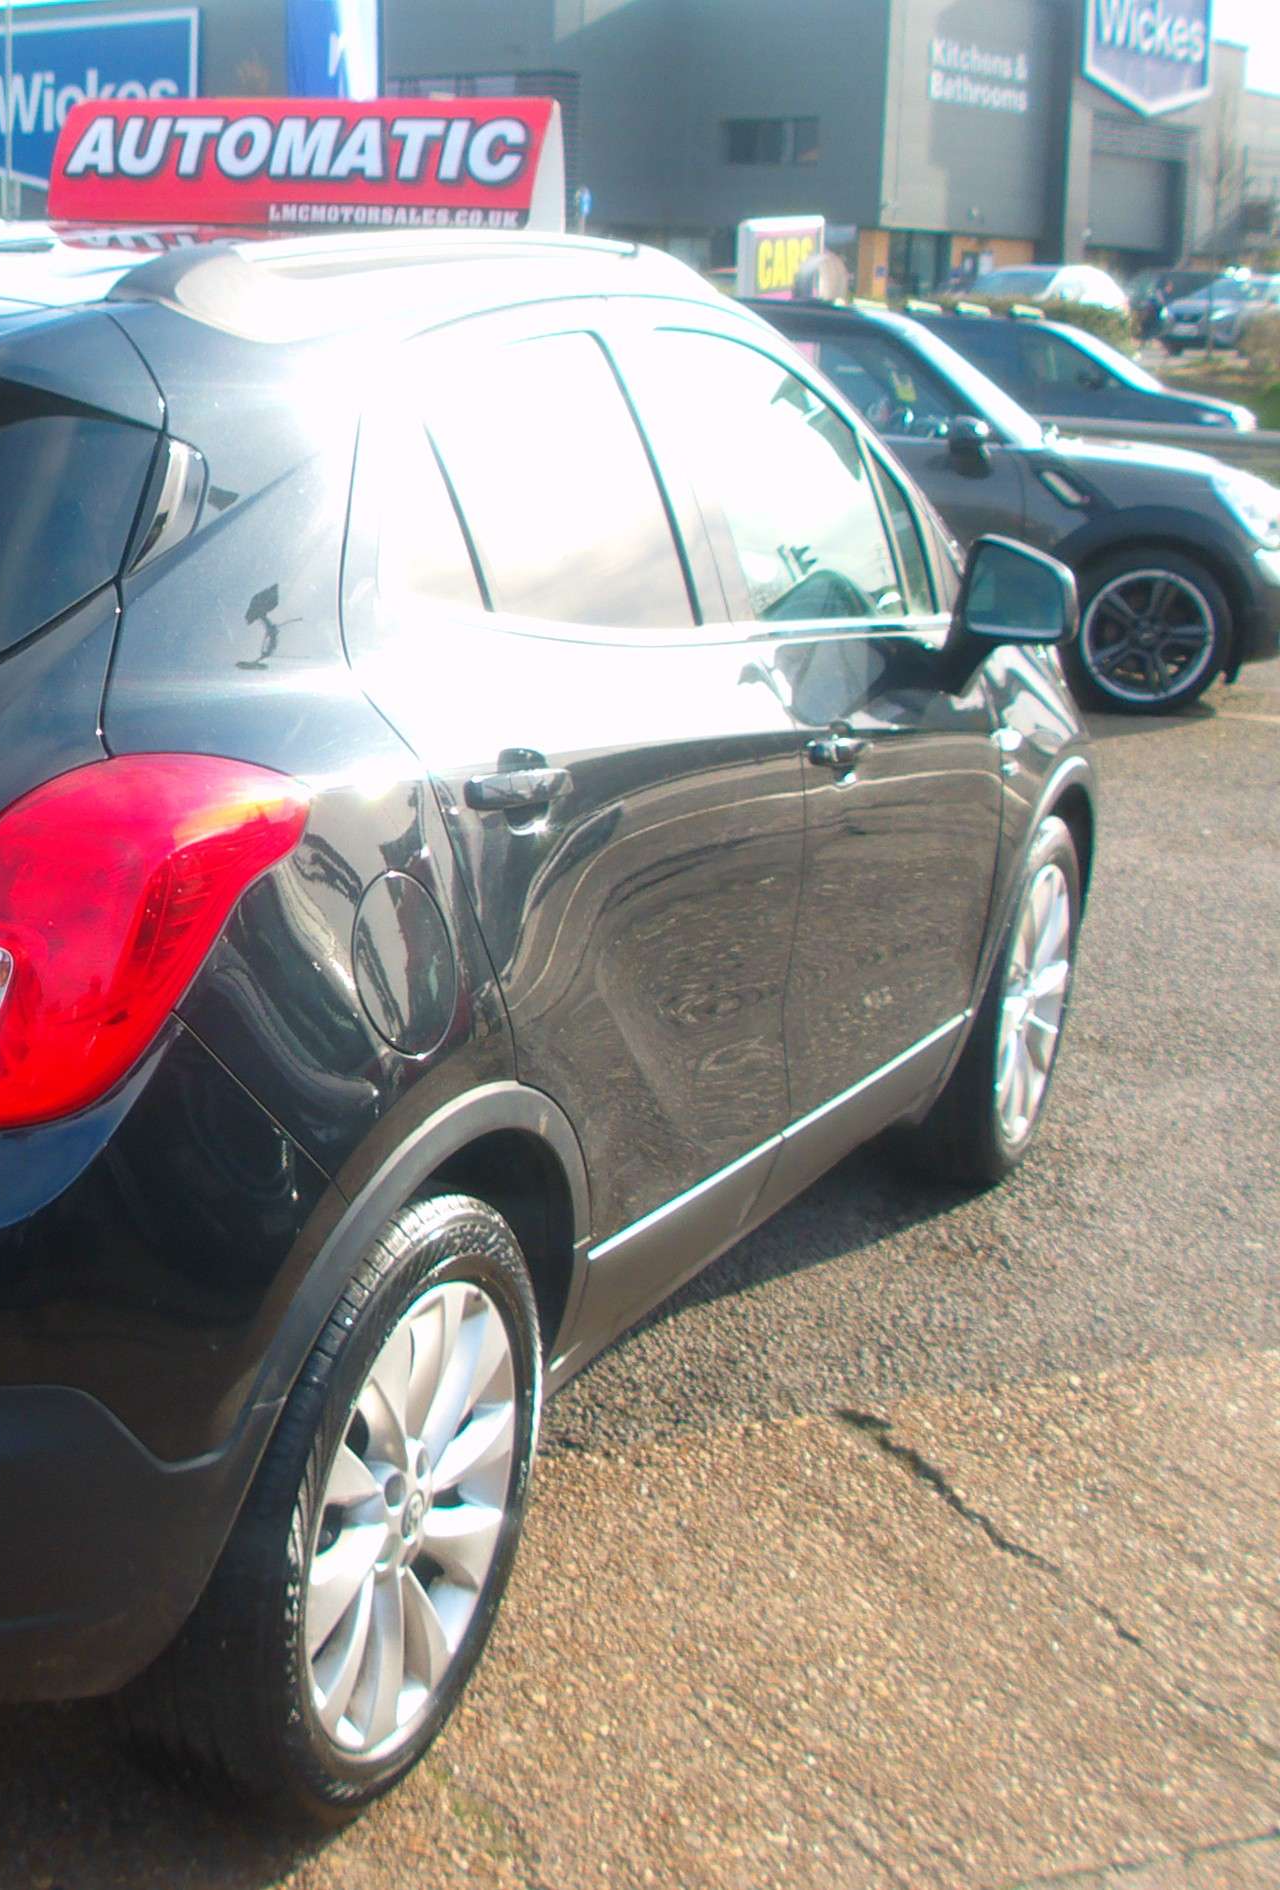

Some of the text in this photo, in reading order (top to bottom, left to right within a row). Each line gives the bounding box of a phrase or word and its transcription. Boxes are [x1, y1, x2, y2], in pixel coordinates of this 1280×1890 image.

[1093, 0, 1205, 63] Wickes
[930, 37, 1028, 80] Kitchens &
[929, 68, 1028, 112] Bathrooms
[65, 116, 528, 184] AUTOMATIC
[269, 203, 519, 228] LMCMOTORSALES.CO.UK
